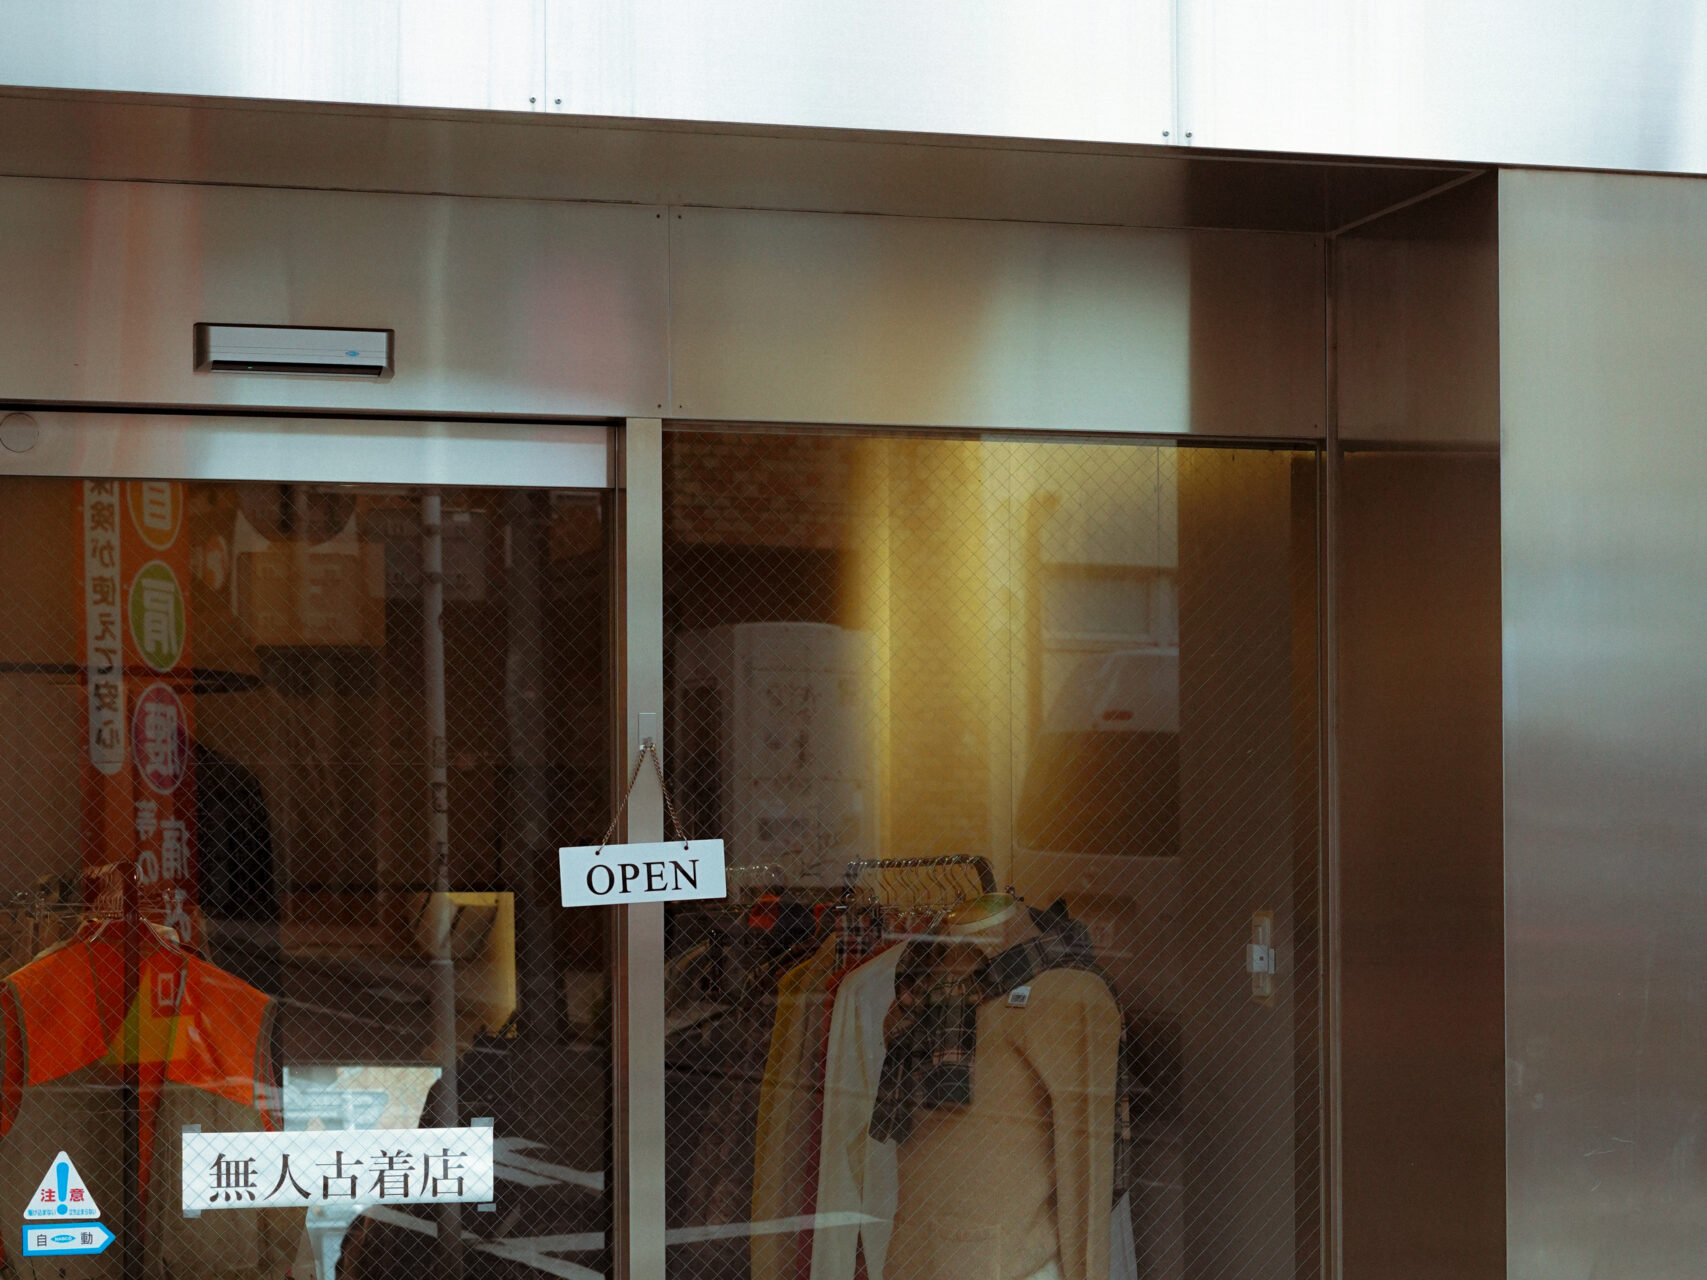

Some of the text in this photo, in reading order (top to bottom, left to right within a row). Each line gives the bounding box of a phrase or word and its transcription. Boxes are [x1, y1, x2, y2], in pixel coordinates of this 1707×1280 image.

[586, 859, 700, 896] OPEN
[209, 1147, 468, 1203] 無人古着店
